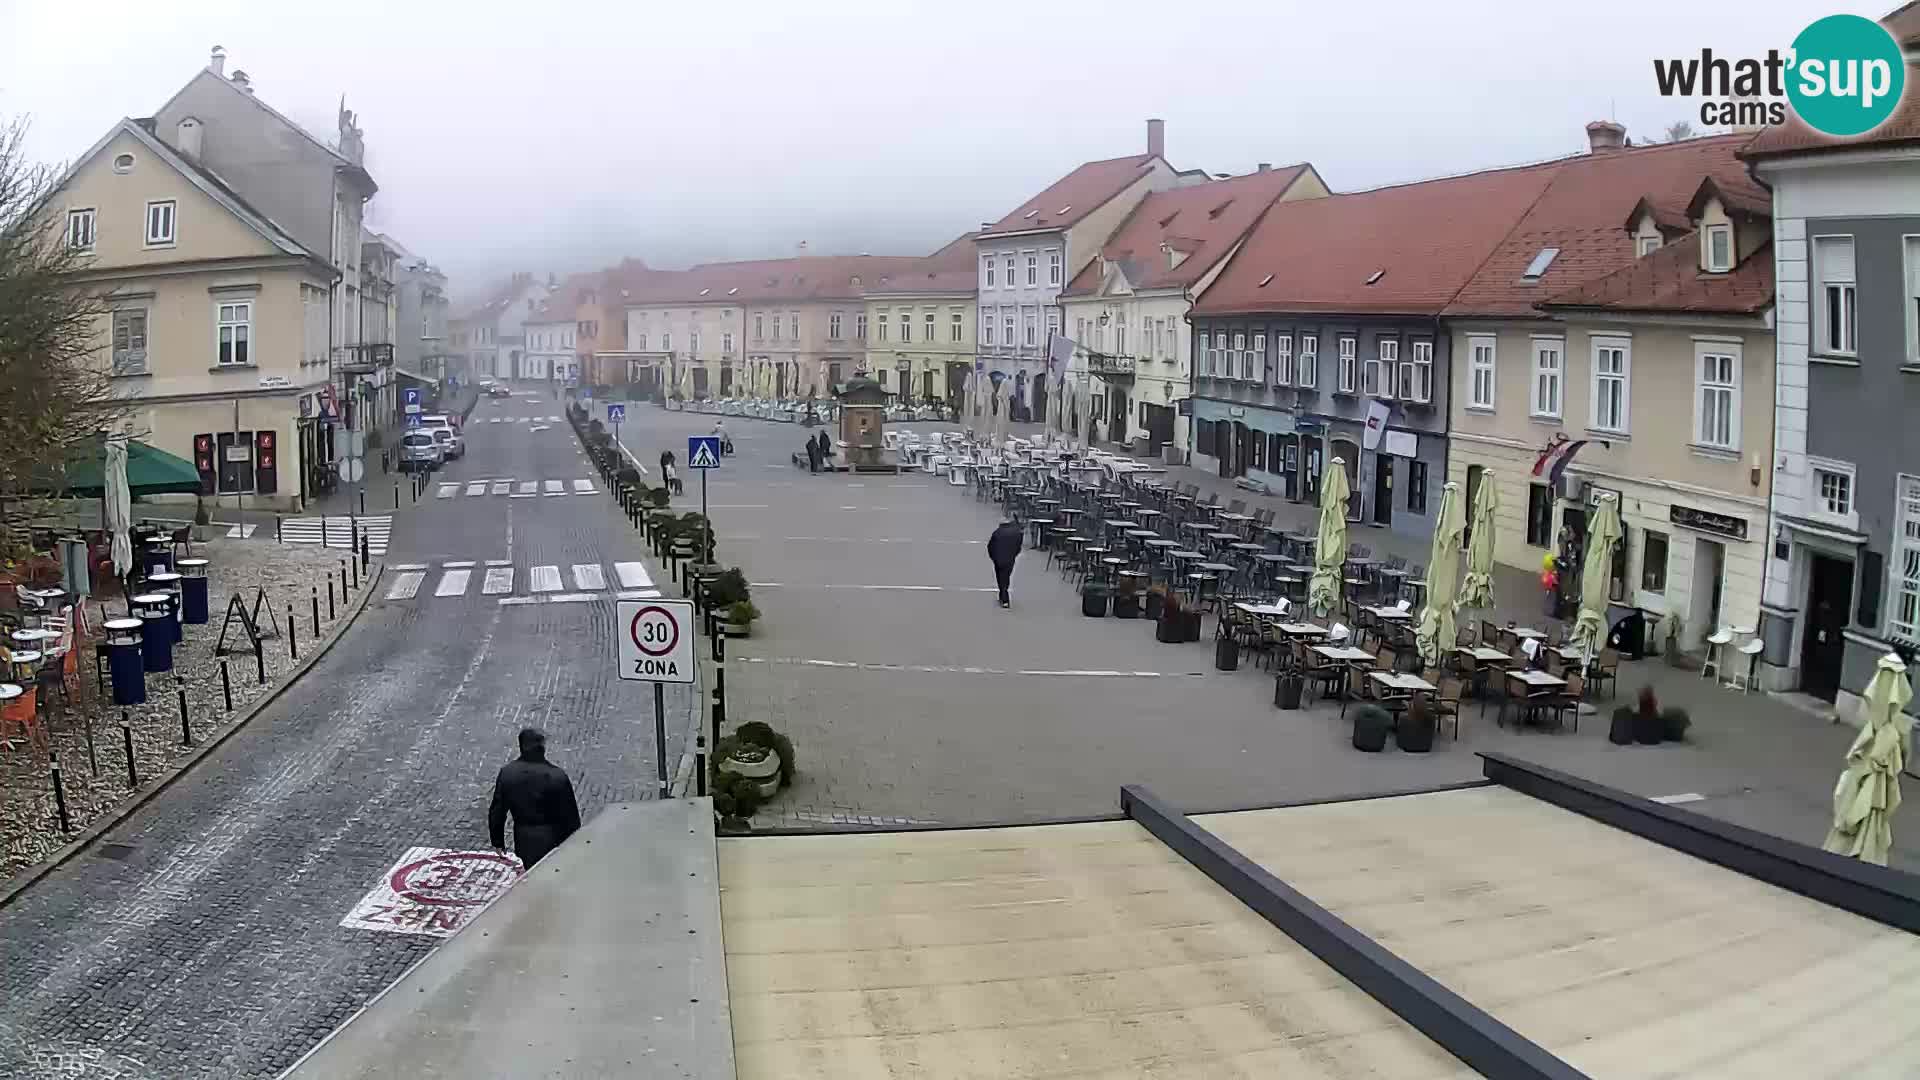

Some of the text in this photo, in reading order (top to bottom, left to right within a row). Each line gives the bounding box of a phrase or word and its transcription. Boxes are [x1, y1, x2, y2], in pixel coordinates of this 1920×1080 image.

[408, 391, 417, 403] P
[643, 621, 668, 643] 30
[634, 659, 679, 676] ZONA
